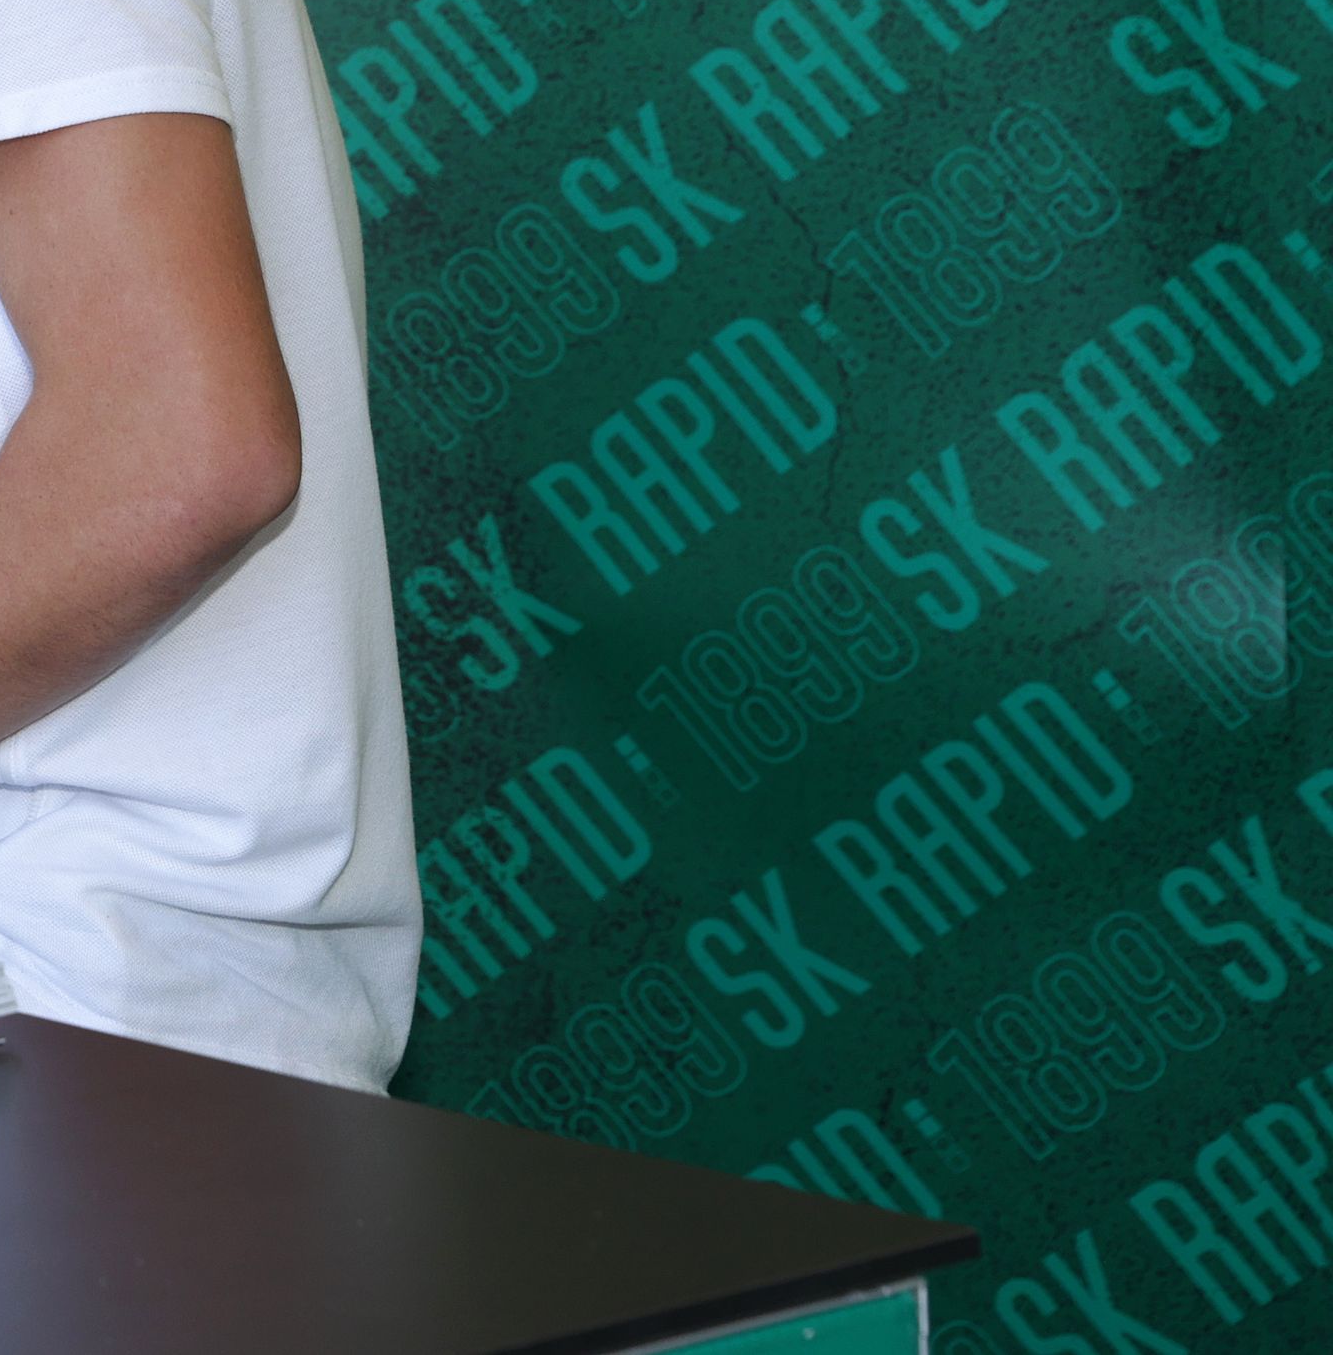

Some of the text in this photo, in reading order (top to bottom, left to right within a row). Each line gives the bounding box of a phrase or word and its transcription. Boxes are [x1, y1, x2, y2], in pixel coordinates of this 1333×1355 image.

[560, 101, 746, 284] SK
[402, 511, 584, 692] SK
[527, 316, 836, 597] RAPID
[827, 101, 1123, 358] 1899
[636, 546, 920, 793] 1899
[859, 444, 1051, 632] SK
[995, 243, 1323, 533] RAPID
[685, 866, 871, 1049] SK
[812, 682, 1135, 957] RAPID
[927, 911, 1226, 1160] 1899
[1160, 815, 1333, 1002] SK
